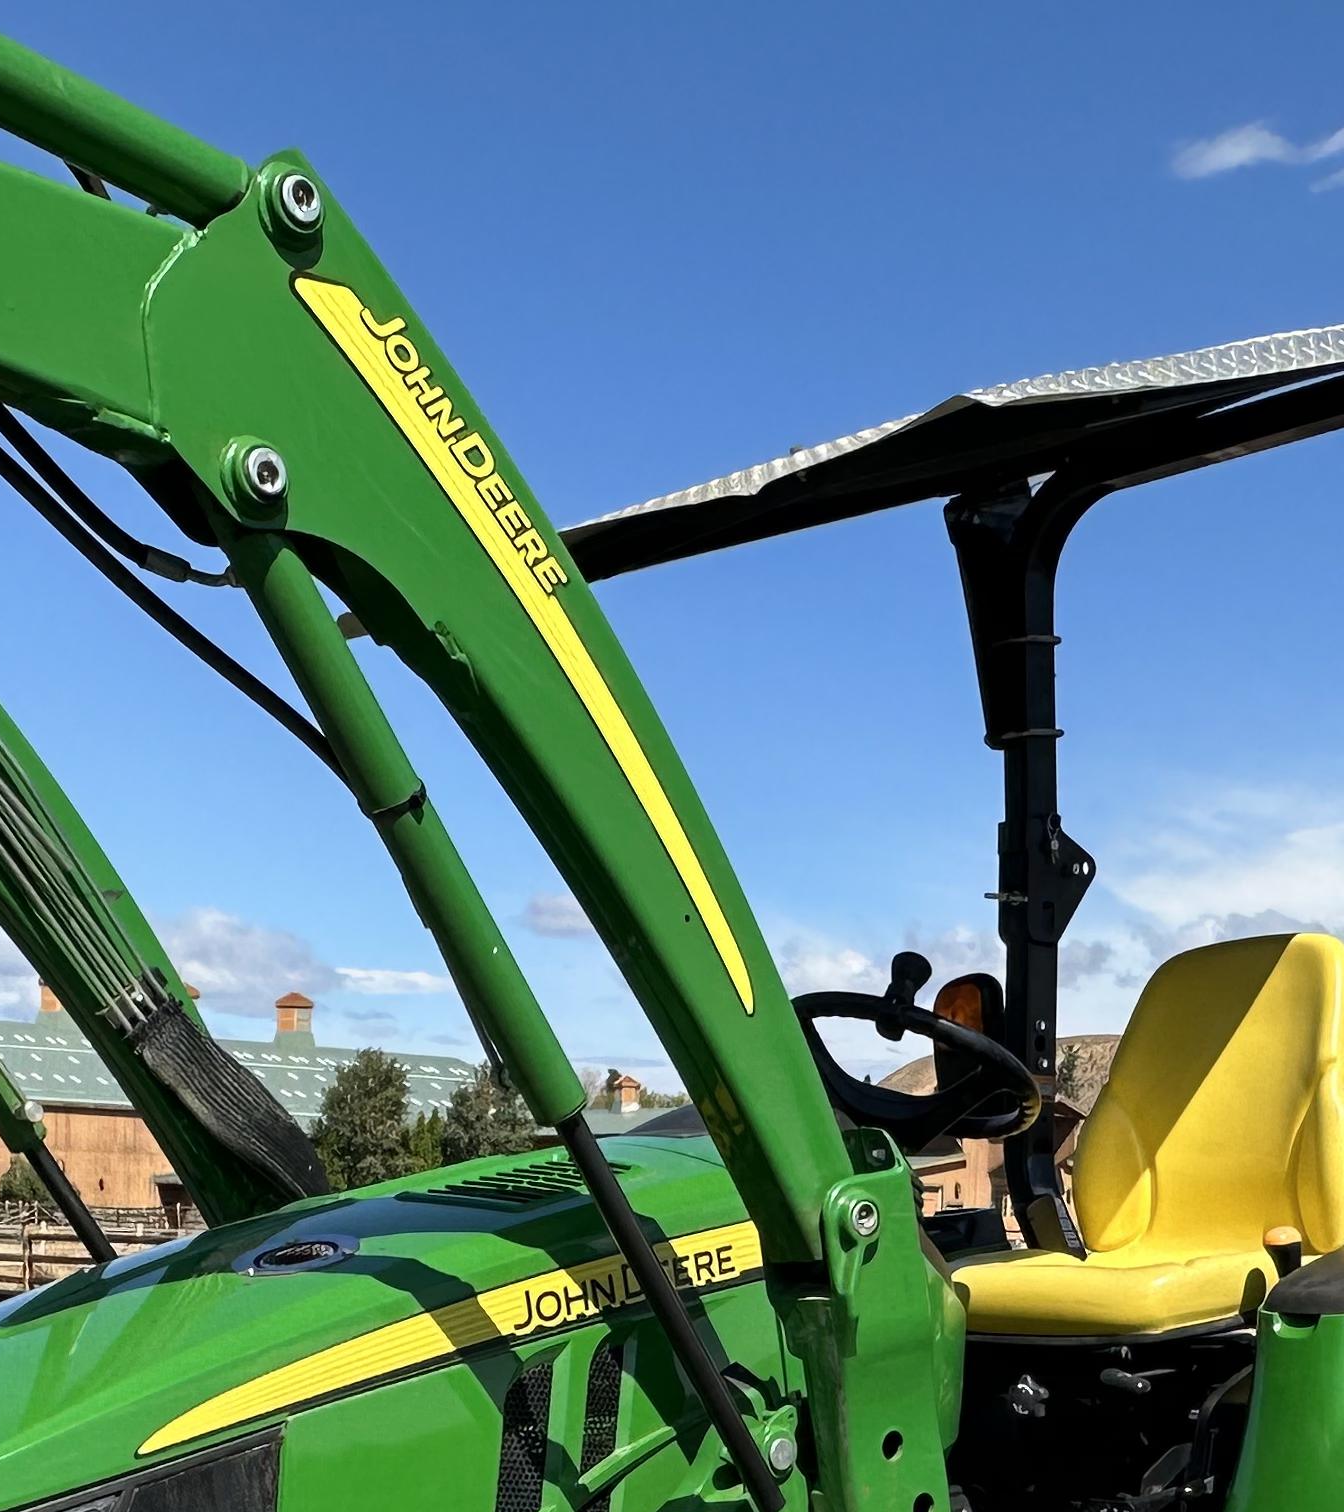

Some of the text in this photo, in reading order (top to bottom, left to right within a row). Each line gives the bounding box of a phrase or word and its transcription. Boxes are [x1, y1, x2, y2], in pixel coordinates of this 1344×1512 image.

[359, 306, 569, 597] JOHN DEERE
[513, 1273, 616, 1330] JOHN
